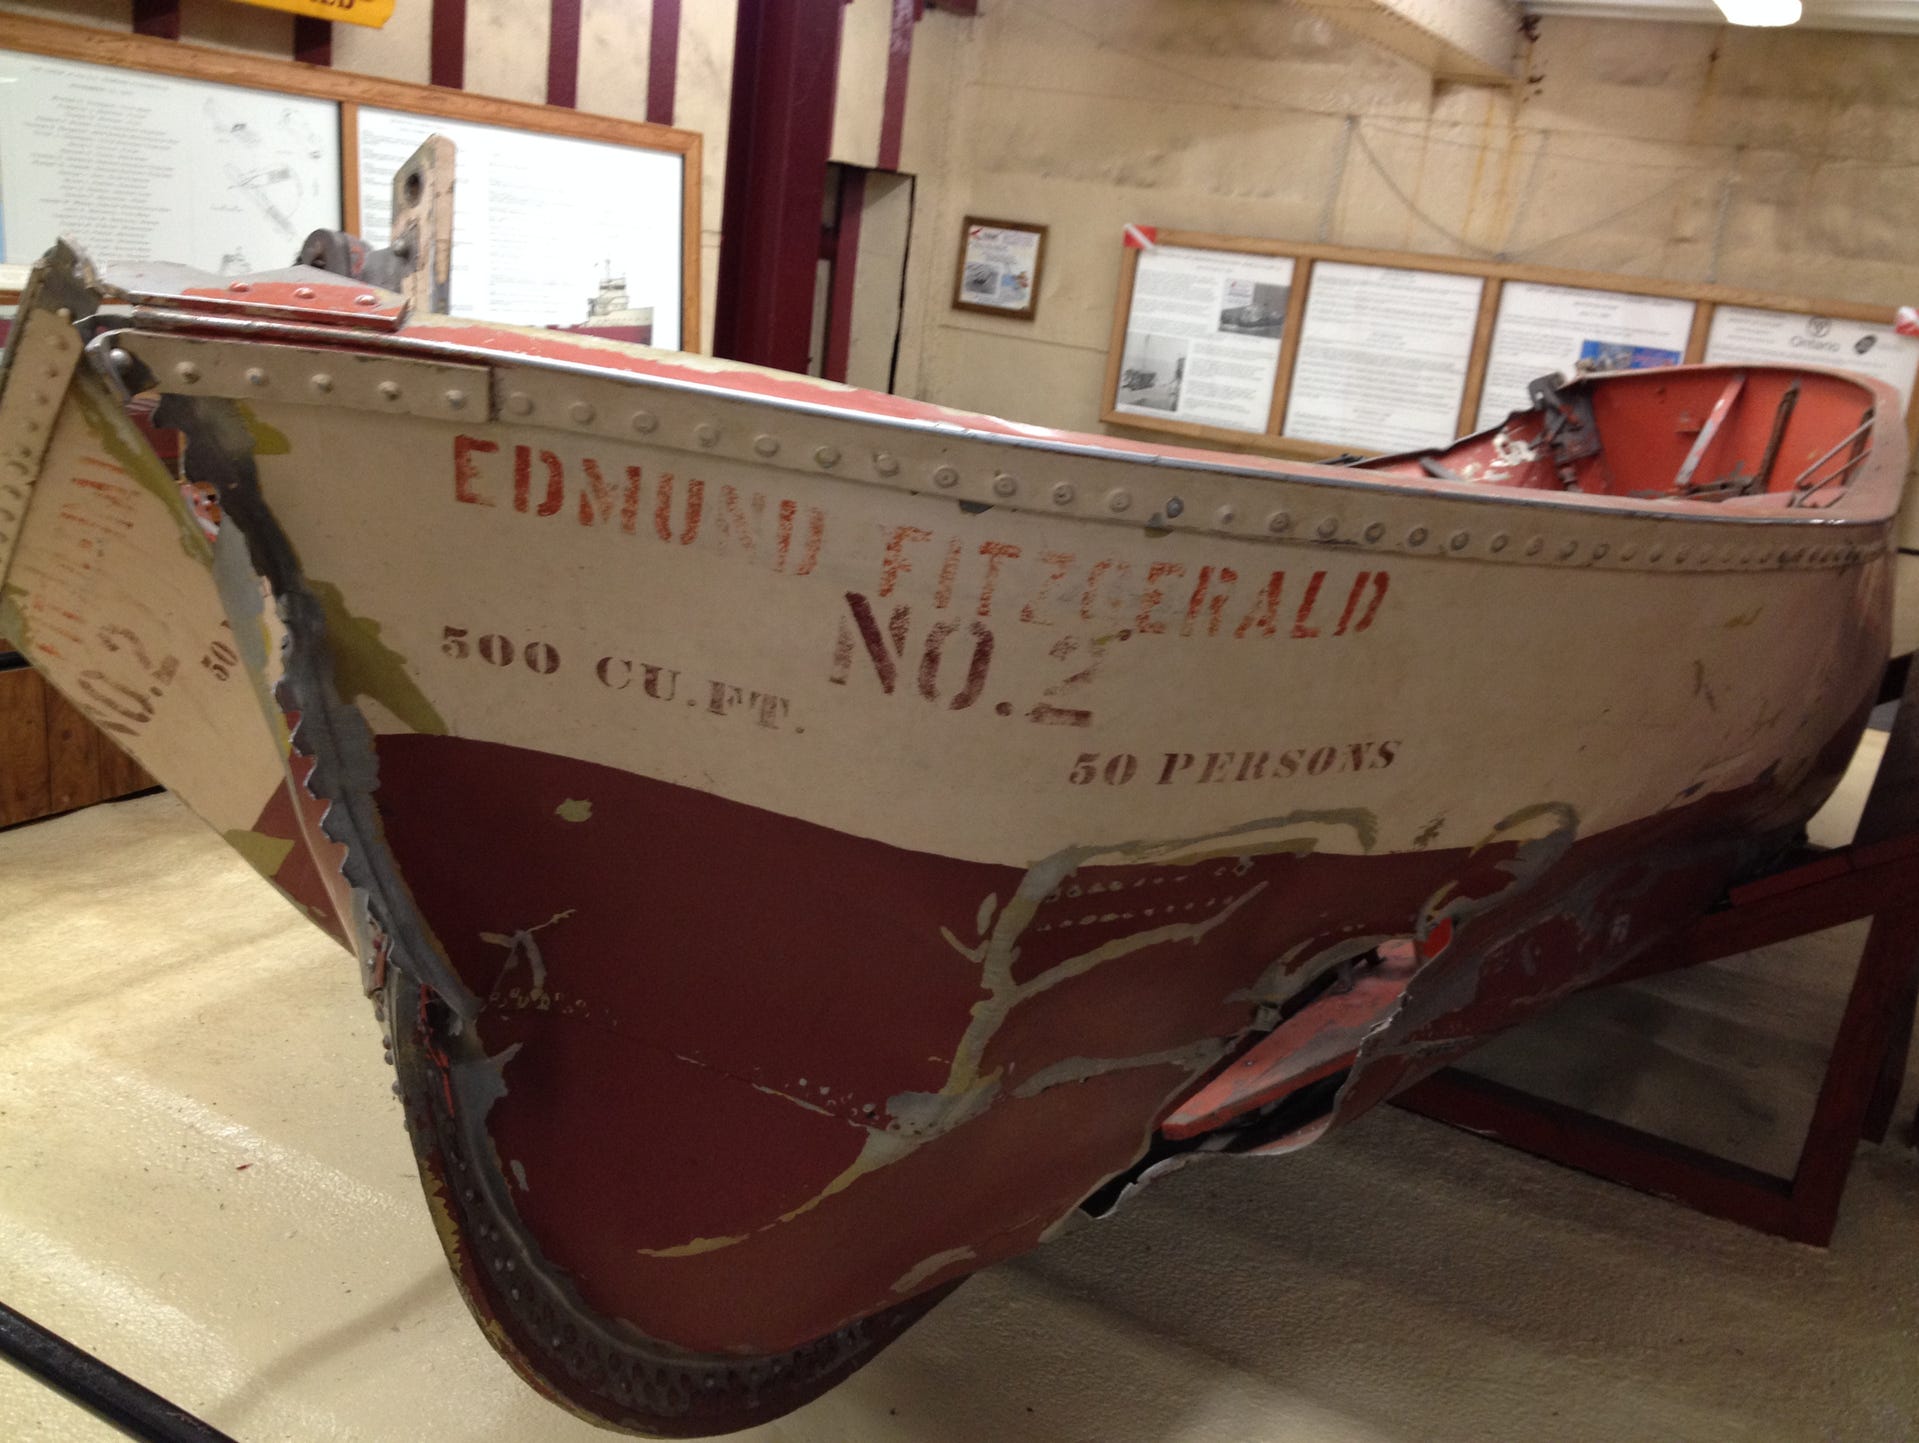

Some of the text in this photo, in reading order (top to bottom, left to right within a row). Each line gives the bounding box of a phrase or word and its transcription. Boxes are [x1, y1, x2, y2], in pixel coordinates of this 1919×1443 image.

[453, 434, 1391, 639] EDMUND FITZGERALD
[440, 625, 561, 675] 500
[1068, 740, 1403, 786] 50 PERSONS
